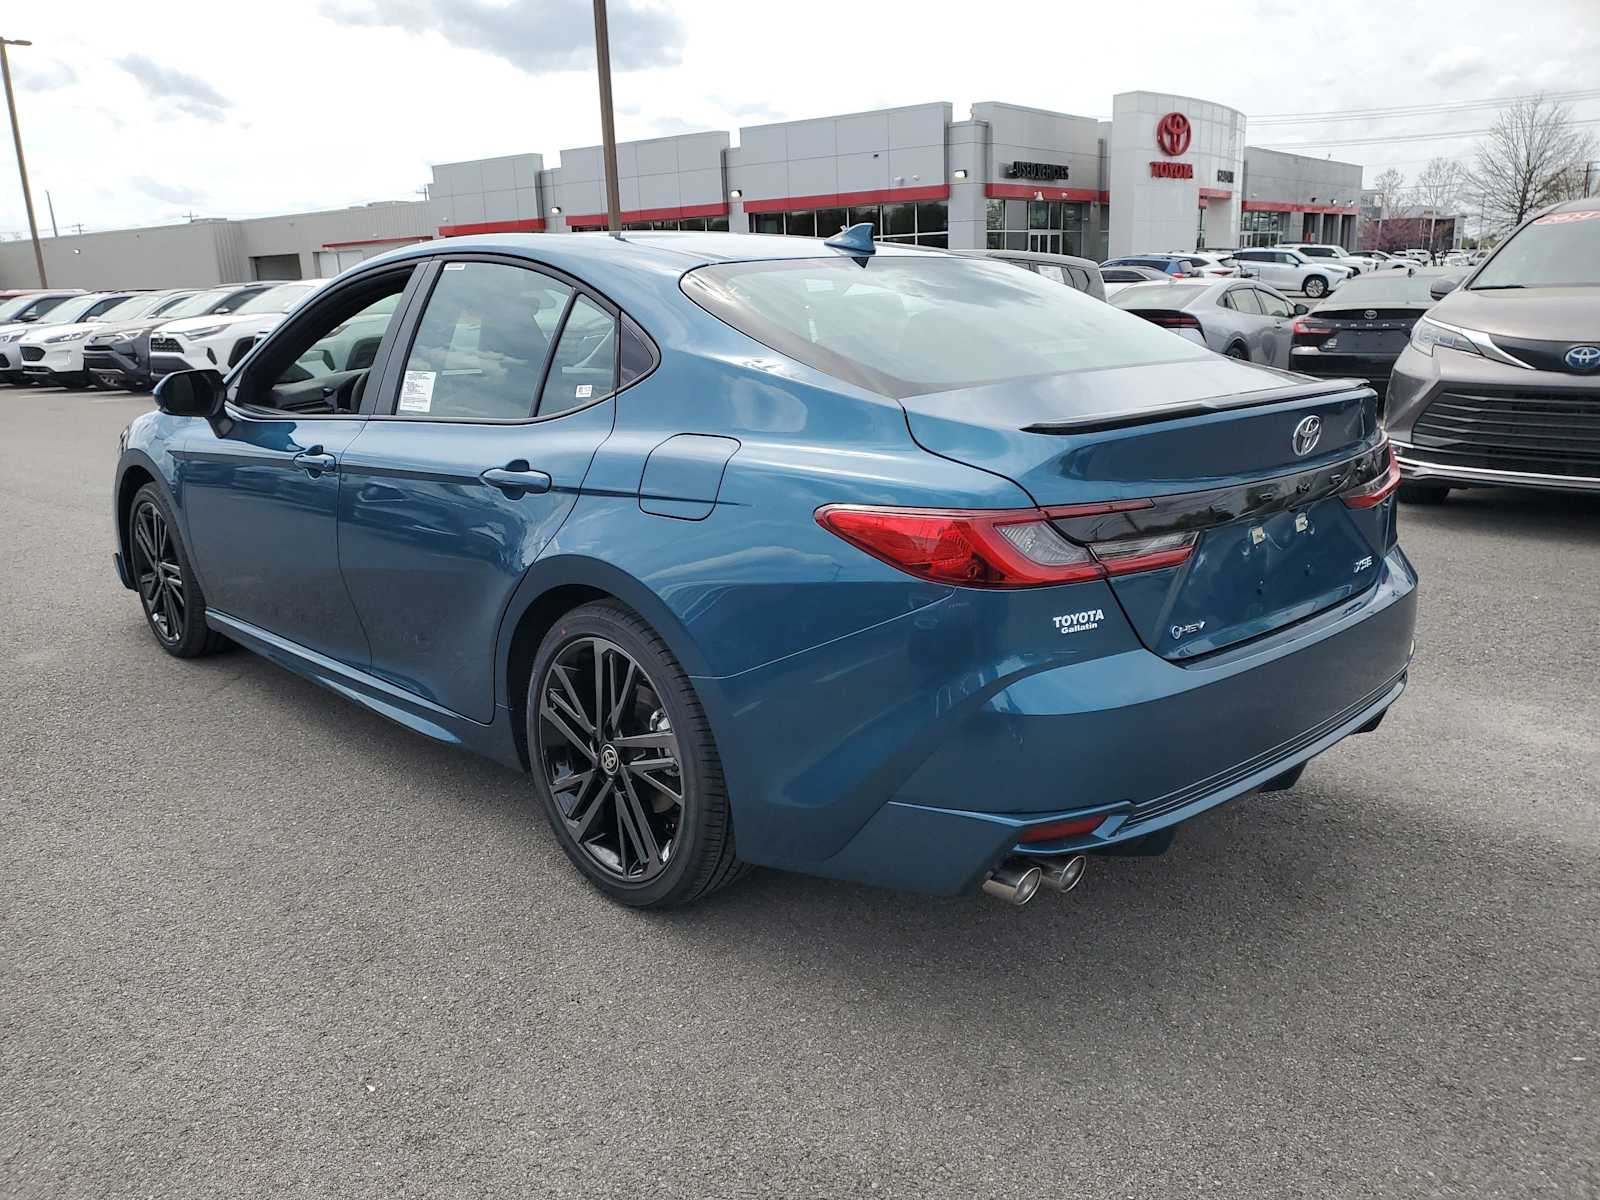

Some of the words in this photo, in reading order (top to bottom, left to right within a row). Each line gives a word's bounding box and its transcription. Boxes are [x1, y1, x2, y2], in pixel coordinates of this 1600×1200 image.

[1014, 161, 1036, 177] USED
[1150, 162, 1193, 178] TOYOTA
[1053, 609, 1105, 628] TOYOTA
[1061, 622, 1098, 634] Gallatin
